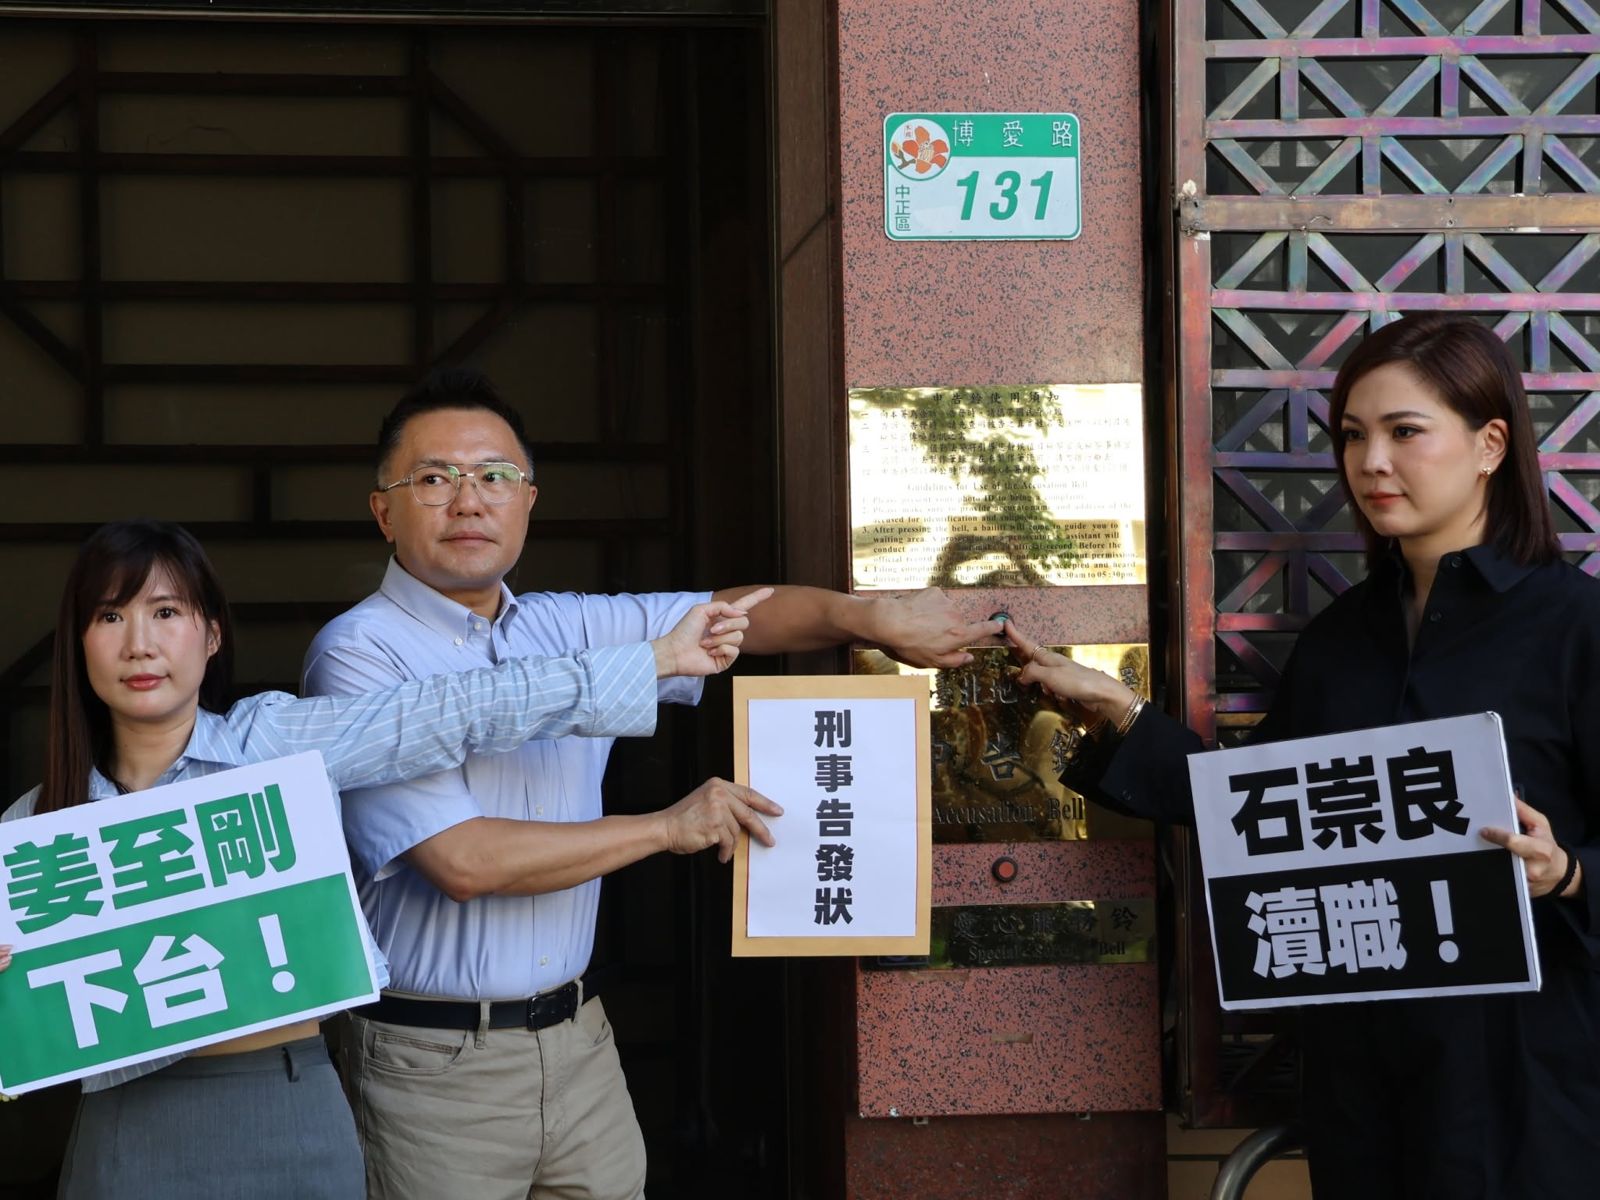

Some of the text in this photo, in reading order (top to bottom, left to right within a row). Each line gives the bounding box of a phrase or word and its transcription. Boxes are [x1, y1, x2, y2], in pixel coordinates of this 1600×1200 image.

[952, 120, 1072, 148] 博愛路
[894, 184, 911, 232] 中正區
[956, 170, 1054, 221] 131
[862, 527, 870, 535] 3.
[873, 526, 897, 534] After
[898, 526, 931, 536] pressing
[952, 524, 970, 533] bell,
[1064, 522, 1086, 531] guide
[1092, 523, 1107, 531] you
[982, 514, 996, 522] and
[873, 536, 904, 545] waiting
[1066, 532, 1101, 540] assistant
[1104, 531, 1120, 539] will
[1079, 541, 1105, 549] Before
[1109, 541, 1121, 549] the
[1057, 552, 1088, 560] without
[933, 797, 1084, 825] Accusation Bell
[1228, 746, 1470, 857] 石崇良
[814, 709, 854, 925] 刑事告發狀
[3, 784, 296, 934] 姜至剛
[1244, 877, 1459, 979] 瀆職！
[1100, 941, 1125, 956] Bell
[27, 913, 296, 1049] 下台！
